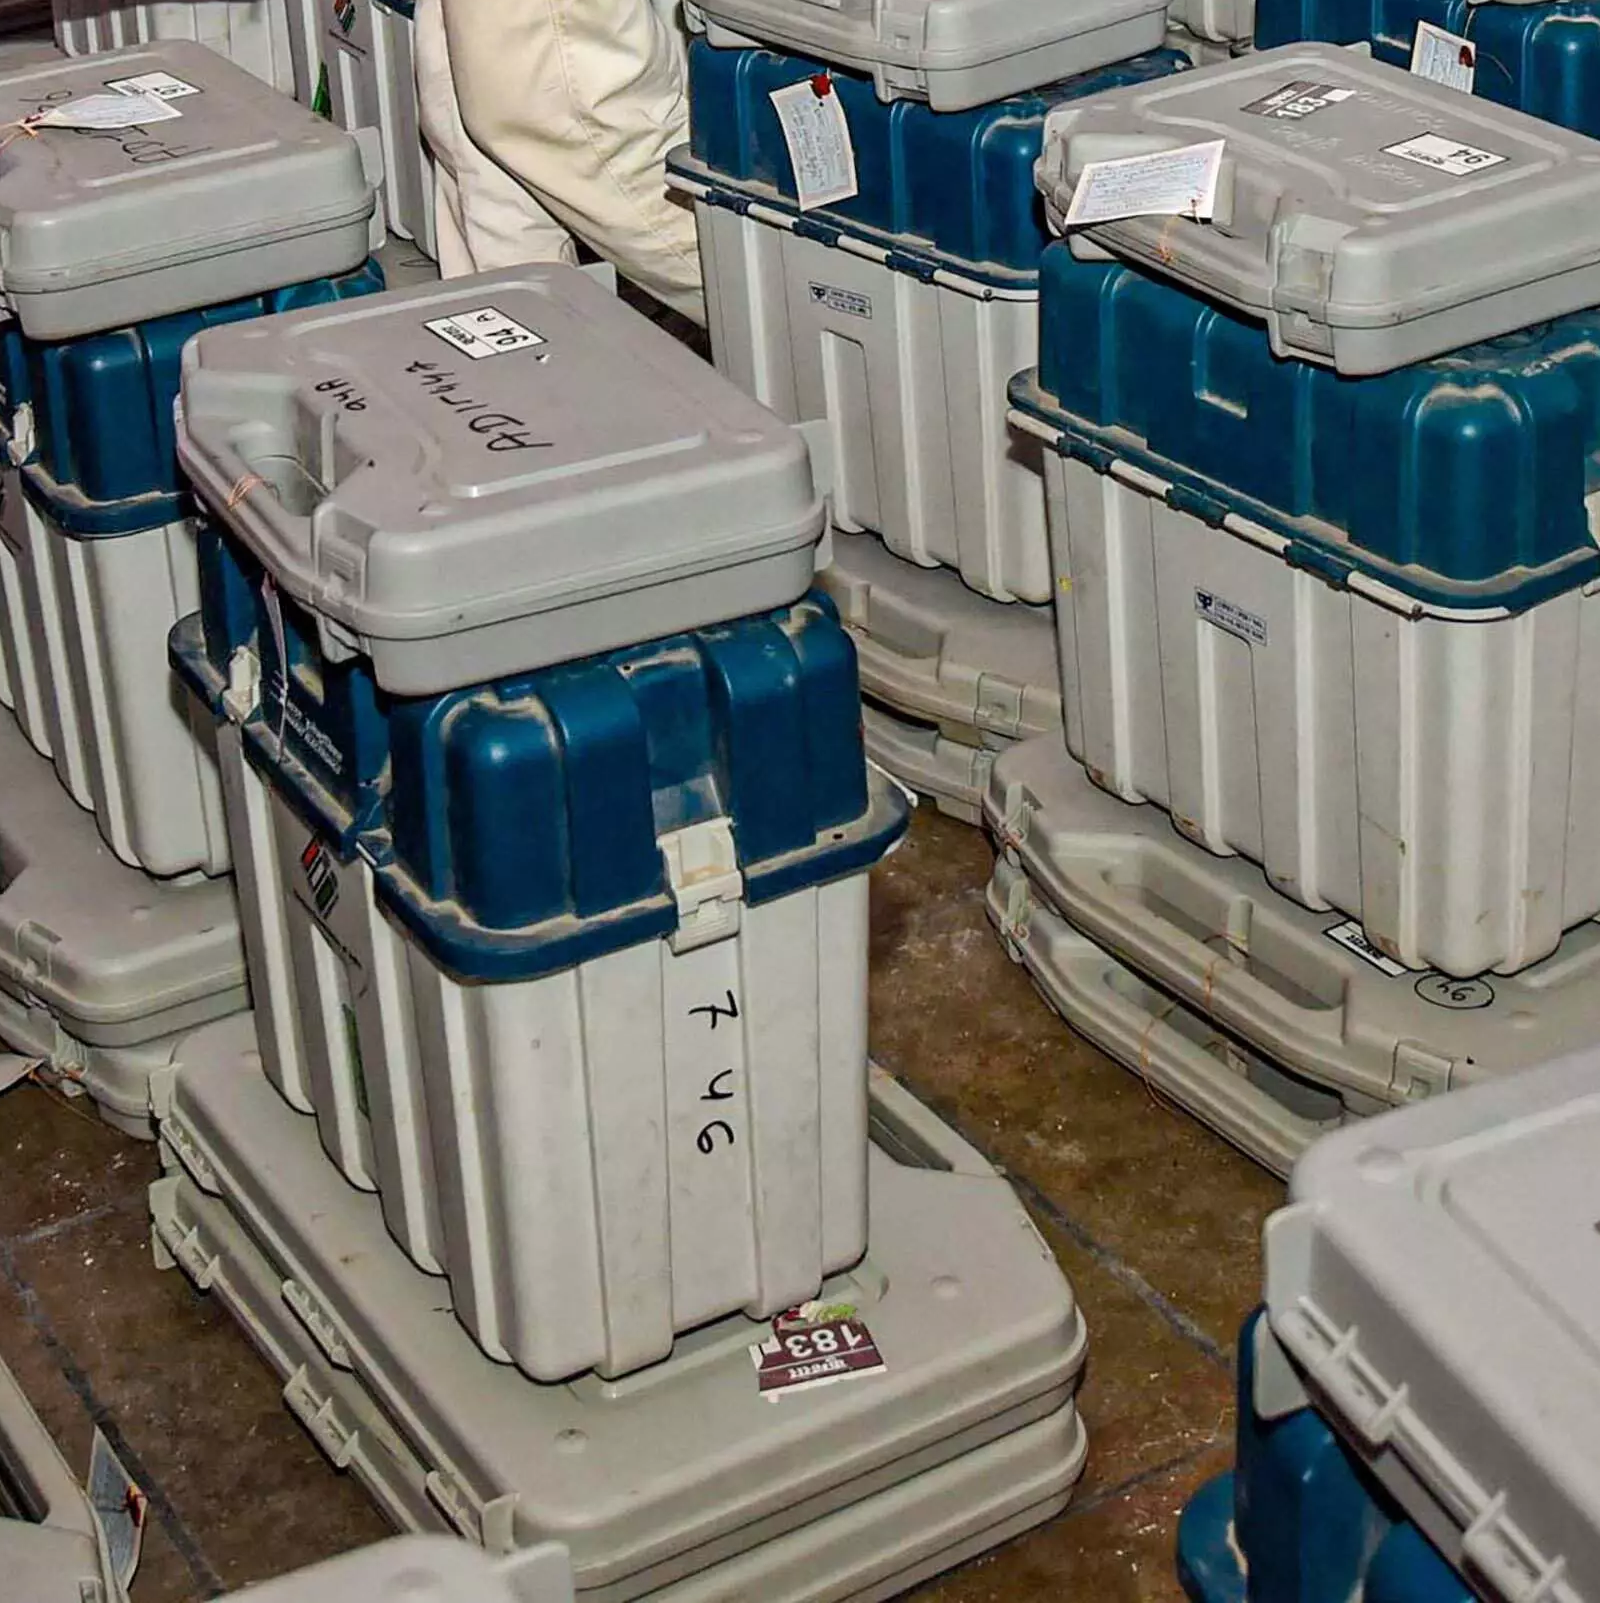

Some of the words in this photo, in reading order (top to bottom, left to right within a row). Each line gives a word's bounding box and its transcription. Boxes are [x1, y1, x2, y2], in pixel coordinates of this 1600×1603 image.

[1275, 96, 1327, 119] 183
[1448, 147, 1491, 165] 94
[484, 325, 530, 346] 94
[784, 1323, 862, 1359] 183
